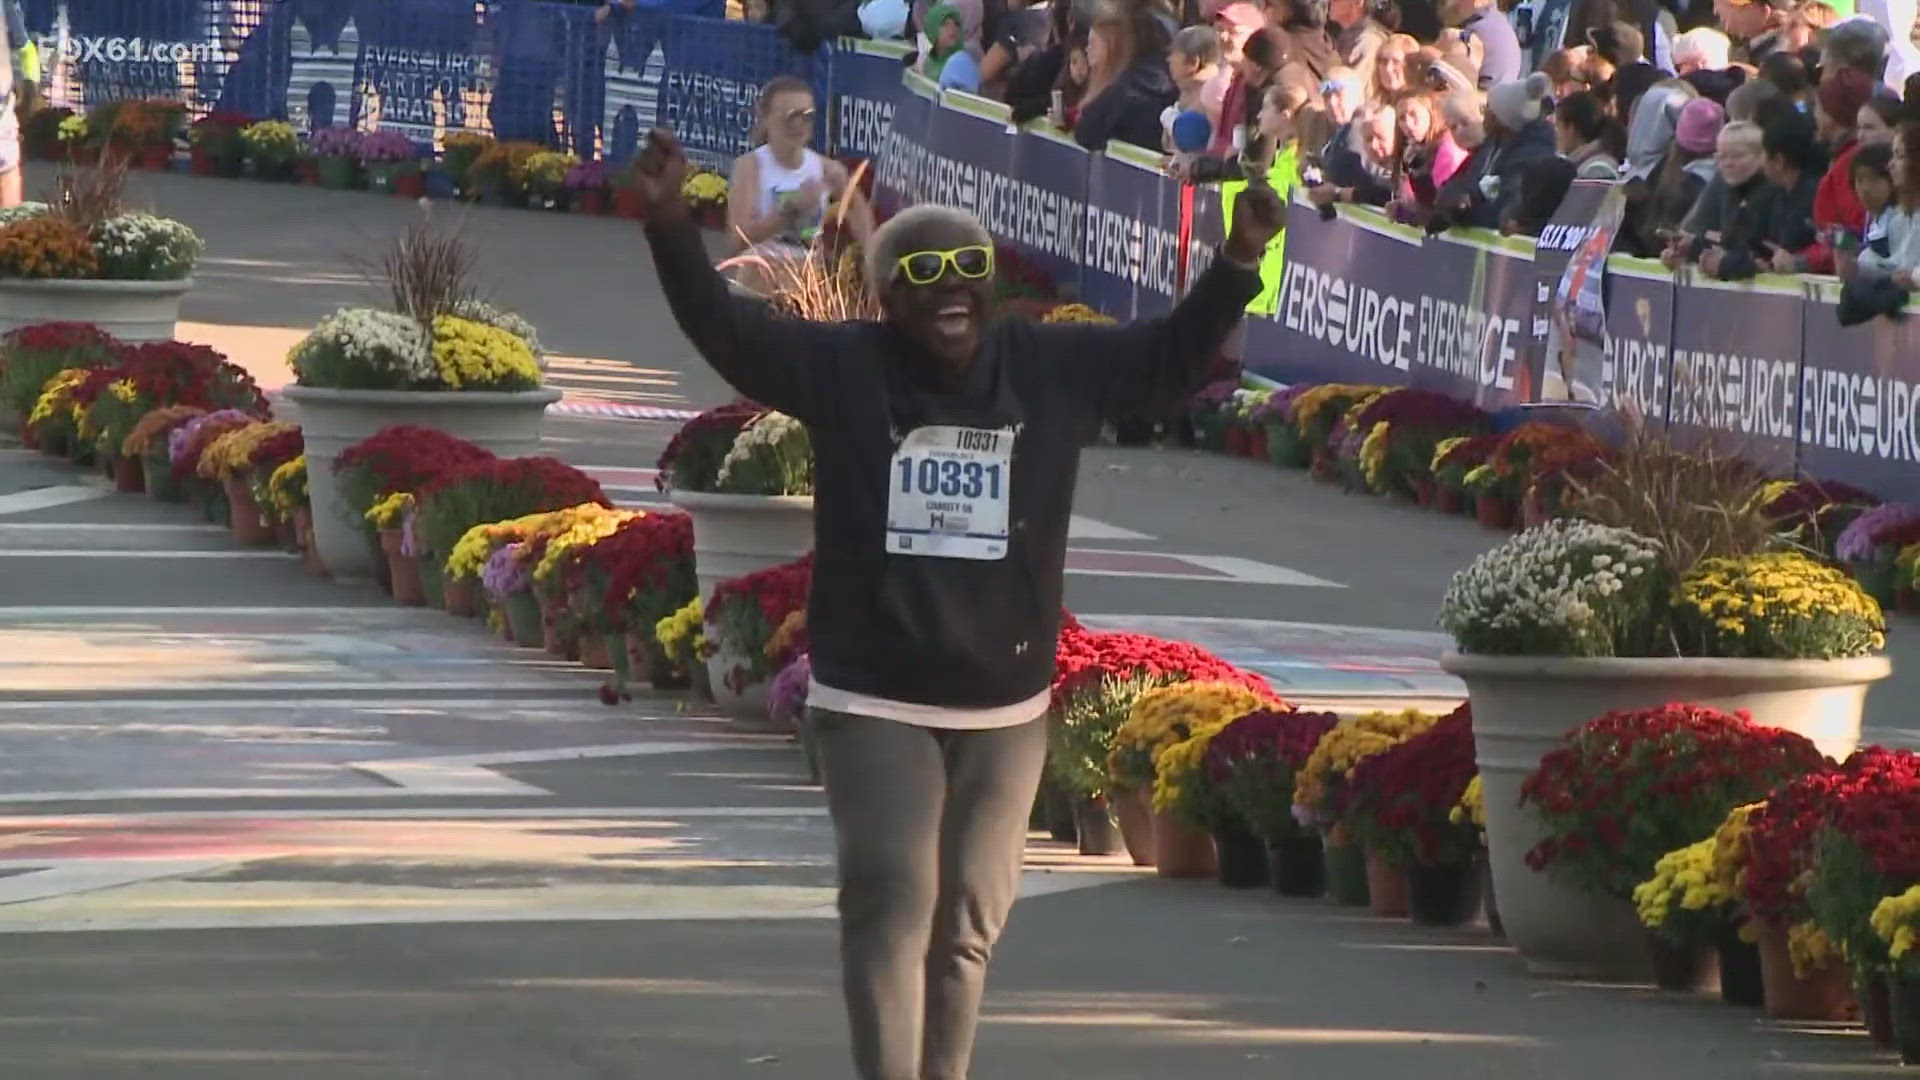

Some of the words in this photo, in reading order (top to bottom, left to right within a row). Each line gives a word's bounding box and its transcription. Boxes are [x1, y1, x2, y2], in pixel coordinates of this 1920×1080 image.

[924, 151, 1009, 235] EVERSOURCE
[1008, 180, 1083, 264] EVERSOURCE
[1085, 203, 1178, 297] EVERSOURCE
[1669, 350, 1797, 439] EVERSOURCE
[898, 456, 1000, 500] 10331
[956, 429, 999, 453] 10331
